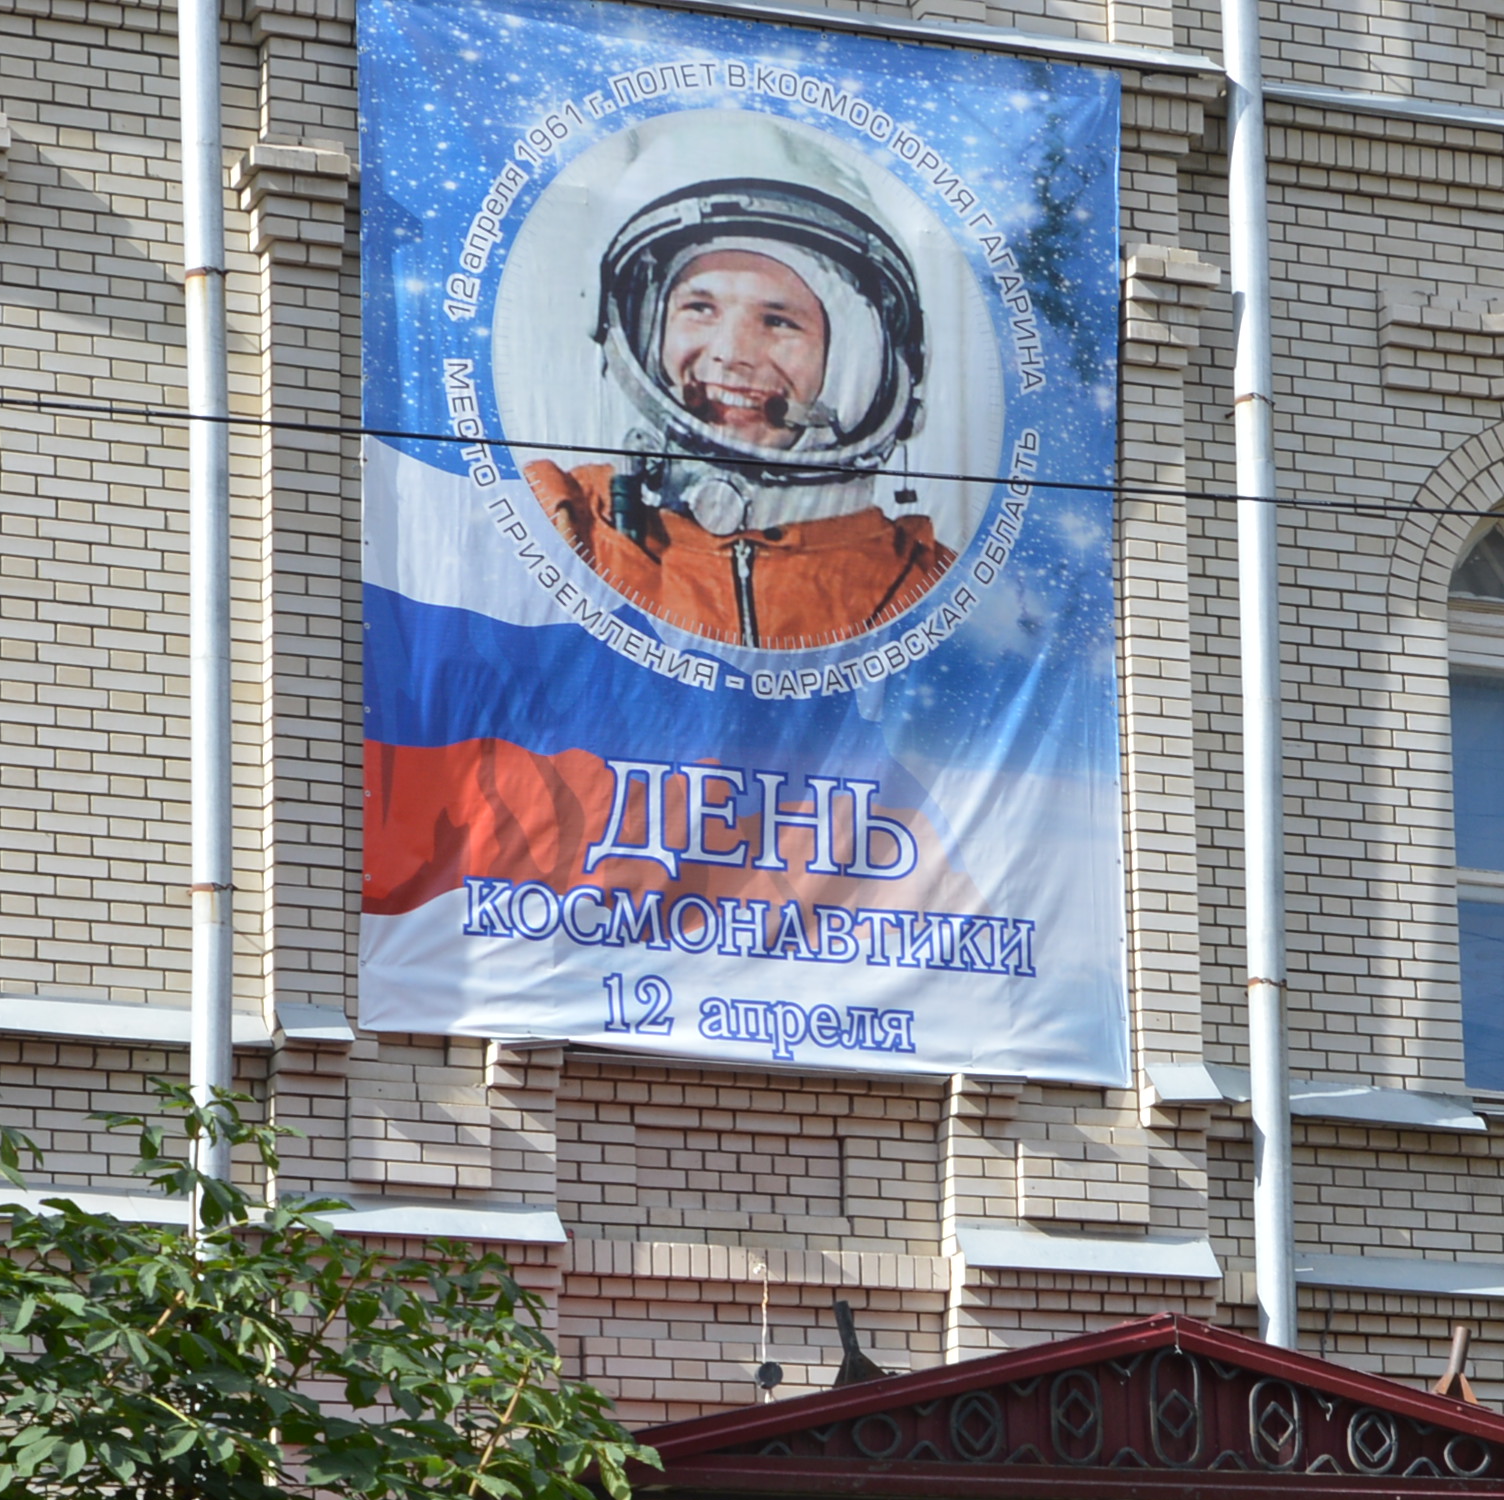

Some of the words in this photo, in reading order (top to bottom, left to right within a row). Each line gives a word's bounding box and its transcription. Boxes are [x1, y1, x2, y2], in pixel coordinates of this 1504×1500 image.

[446, 272, 477, 318] 12
[463, 166, 525, 273] апреля
[516, 103, 584, 164] 1961
[613, 63, 717, 104] ПОЛЕТ
[727, 63, 747, 88] В
[756, 66, 891, 140] КОСМОС
[891, 130, 976, 214] ЮРИЯ
[968, 212, 1044, 391] ГАГАРИНА
[447, 359, 497, 489] МЕСТО
[488, 497, 717, 688] ПРИЗЕМЛЕНИЯ
[755, 586, 977, 697] САРАТОВСКАЯ
[973, 430, 1038, 586] ОБЛАСТЬ
[583, 756, 919, 881] ДЕНЬ
[463, 876, 1037, 978] КОСМОНАВТИКИ
[603, 972, 675, 1036] 12
[698, 997, 917, 1061] апреля
